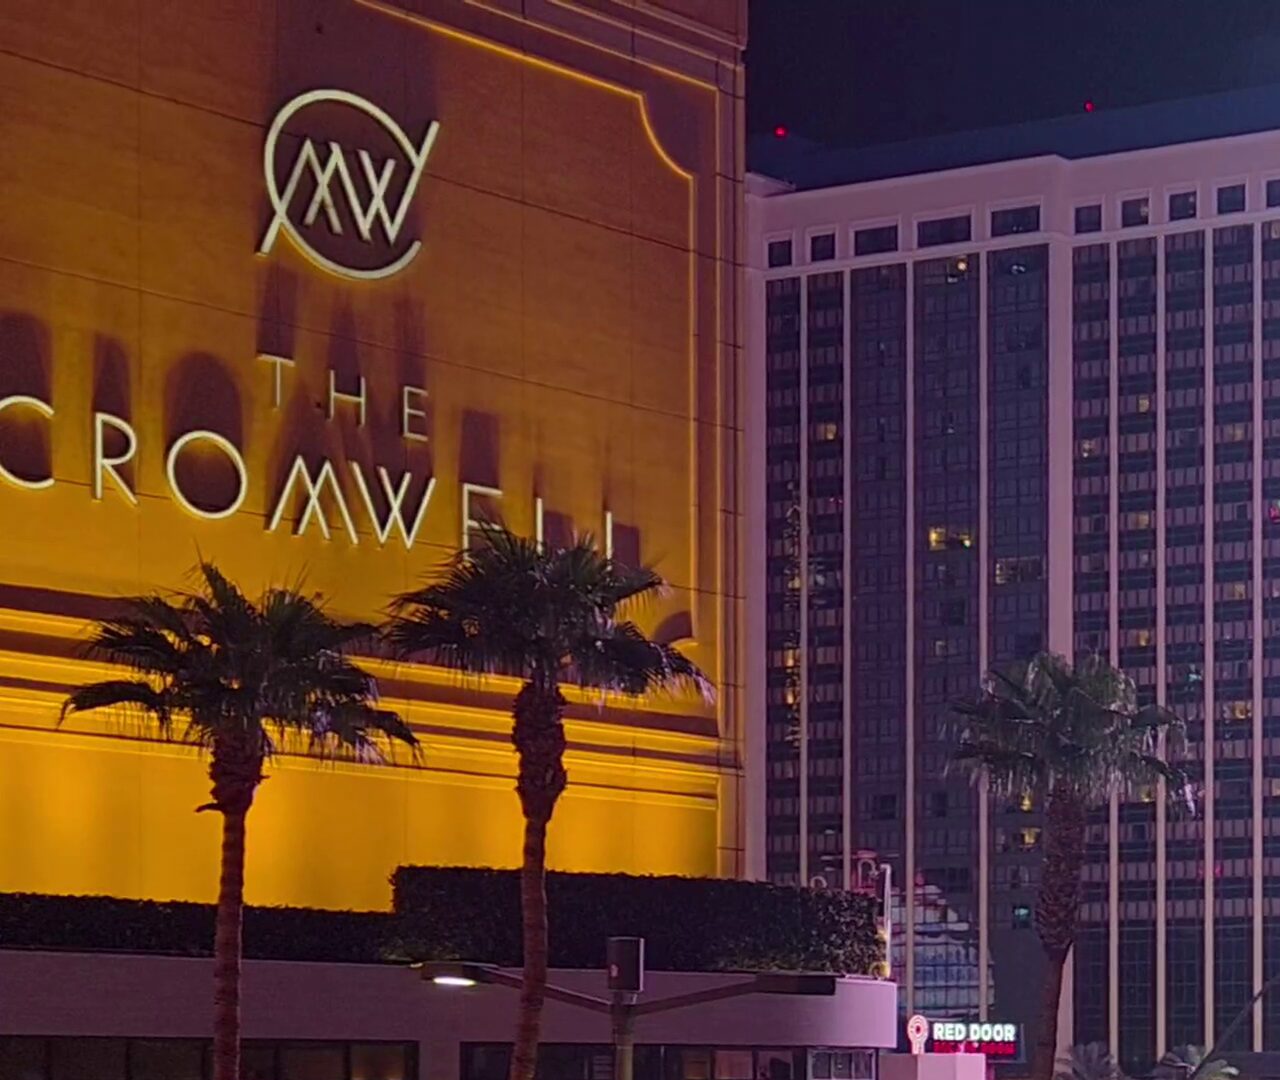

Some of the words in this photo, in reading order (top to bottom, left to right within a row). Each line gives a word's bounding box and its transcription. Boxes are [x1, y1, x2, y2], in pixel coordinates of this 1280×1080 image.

[257, 353, 430, 442] THE
[933, 1022, 967, 1042] RED
[969, 1022, 1017, 1042] DOOR
